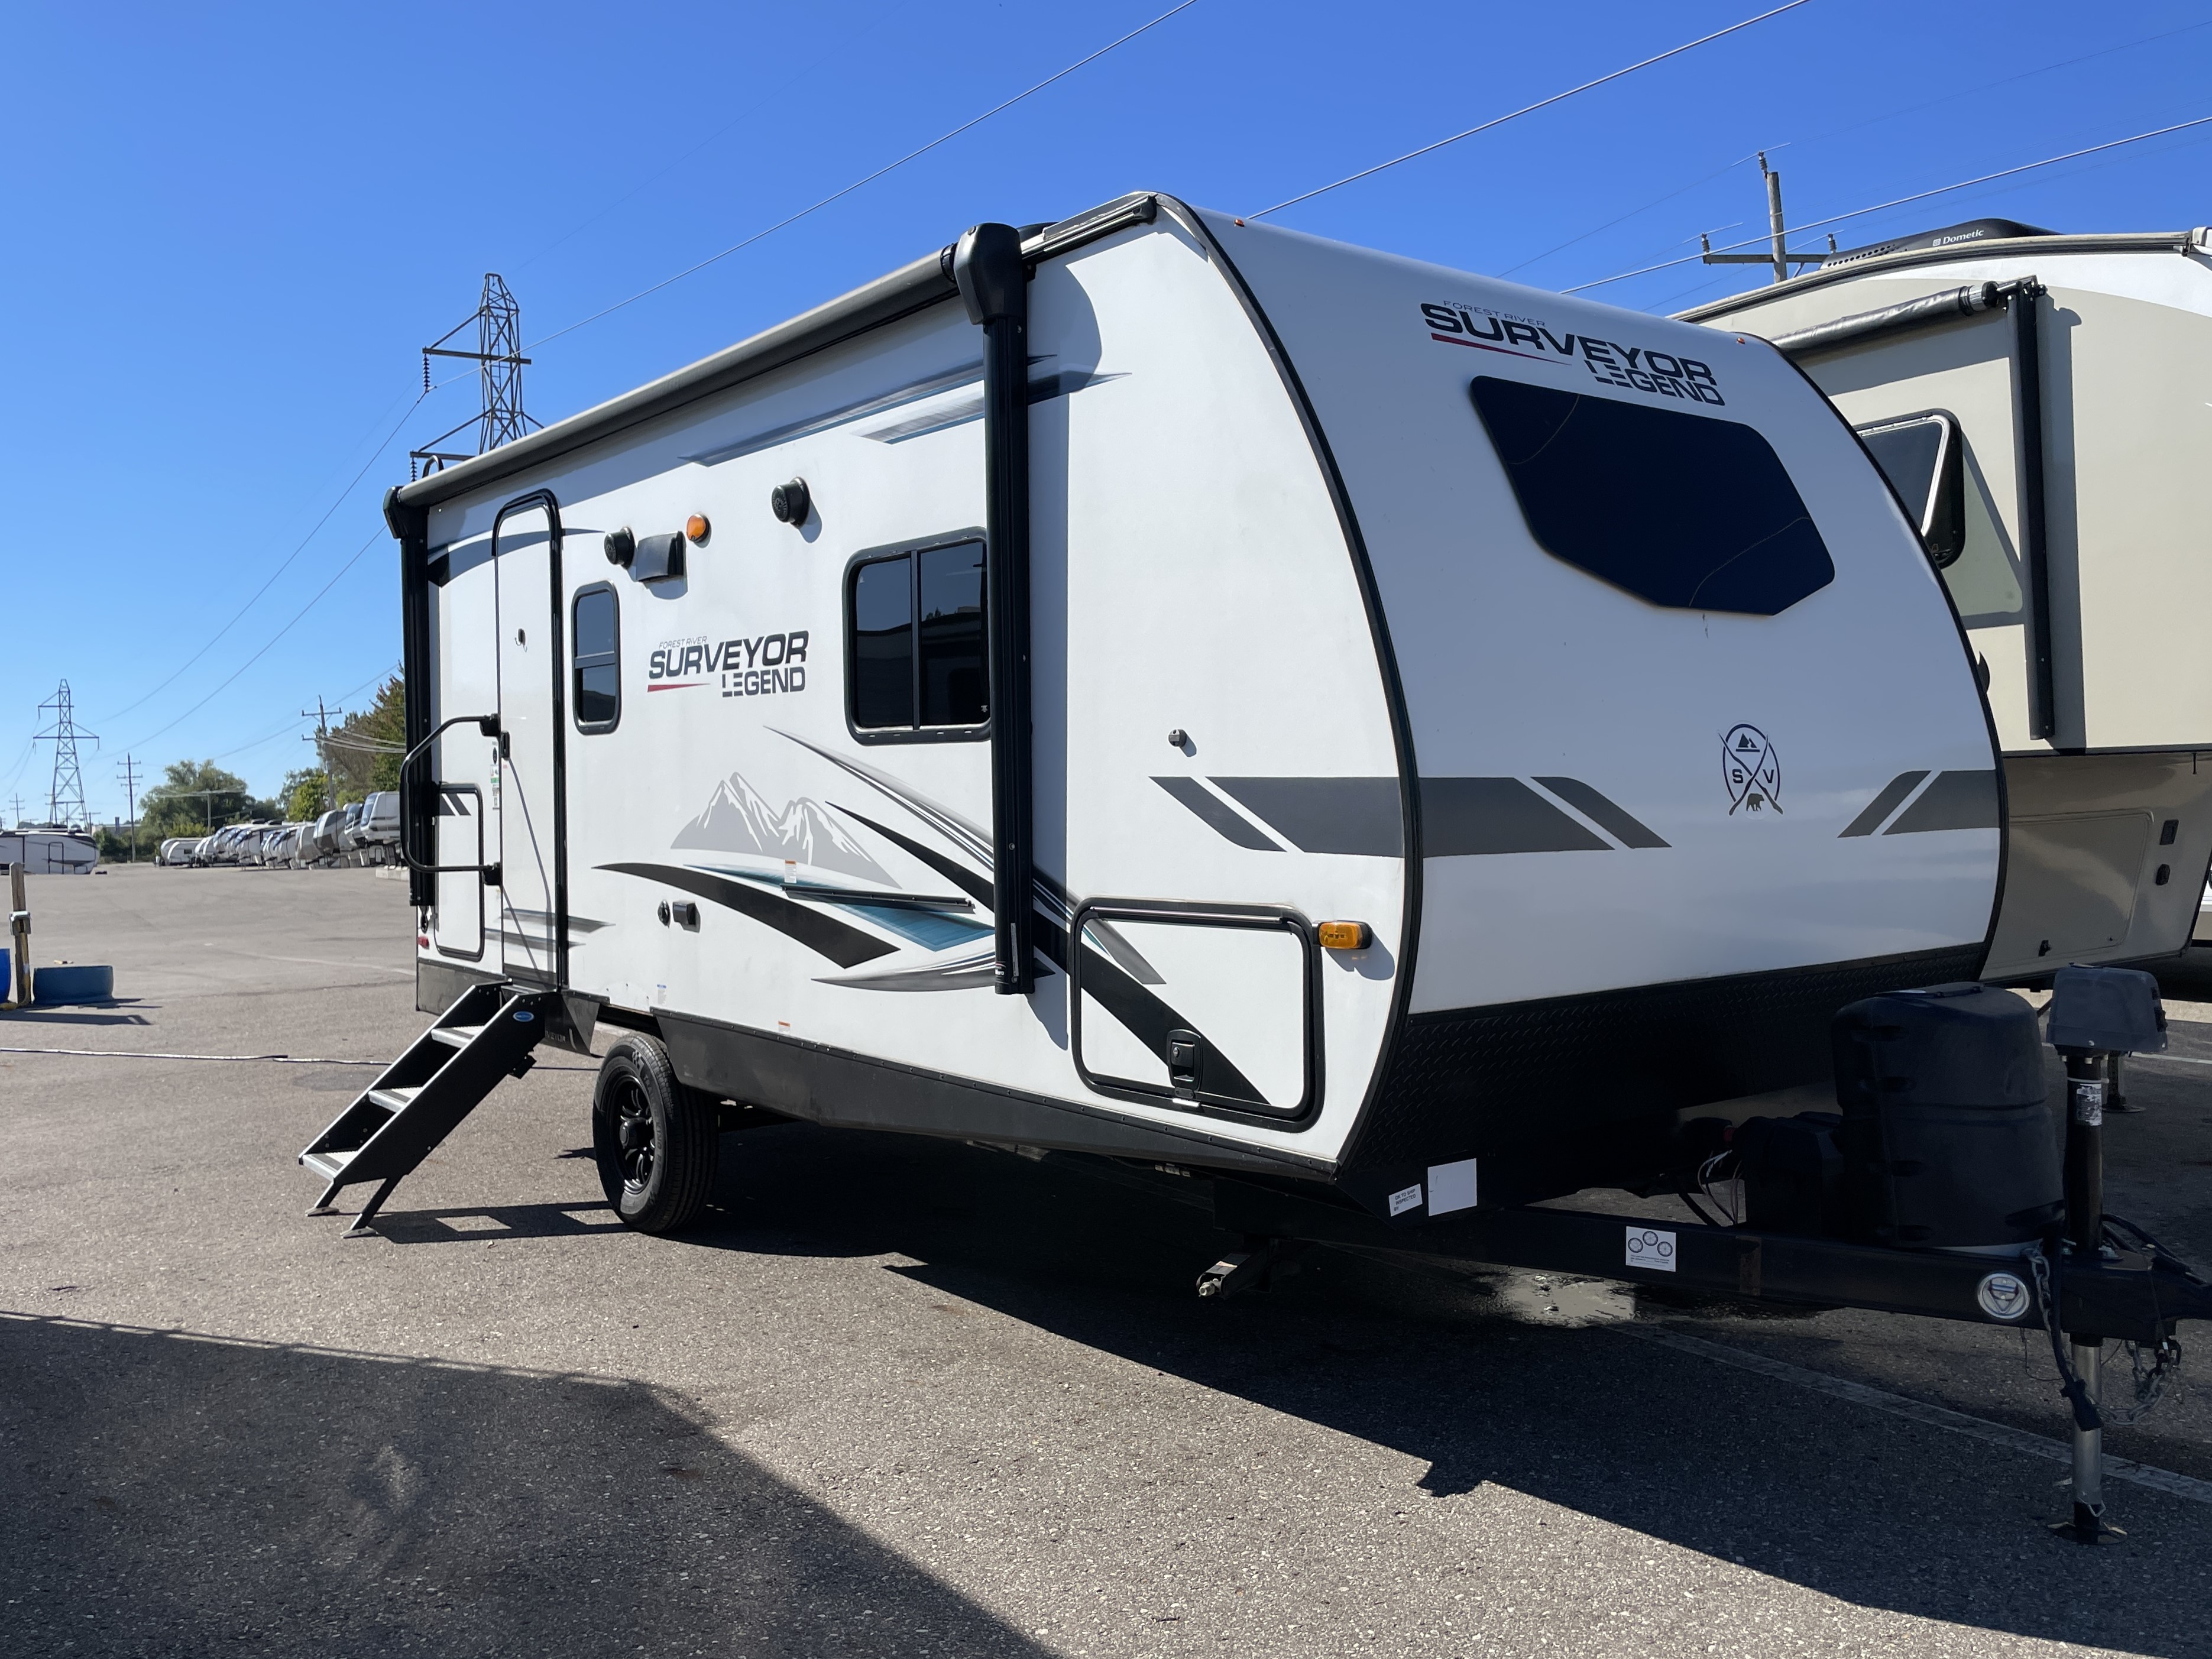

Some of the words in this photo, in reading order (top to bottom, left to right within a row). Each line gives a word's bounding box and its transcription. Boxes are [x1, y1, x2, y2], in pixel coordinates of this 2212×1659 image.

[1943, 229, 1984, 244] Dometic
[1443, 300, 1501, 317] FOREST
[1504, 313, 1546, 328] RIVER
[1420, 303, 1718, 385] SURVEYOR
[1584, 359, 1725, 406] LEGEND
[649, 630, 809, 679] SURVEYOR
[659, 639, 685, 650] FOREST
[686, 636, 707, 646] RIVER
[722, 666, 806, 698] LEGEND
[1732, 769, 1744, 783] S
[1763, 769, 1774, 783] V
[1395, 1194, 1416, 1206] INSPECTED
